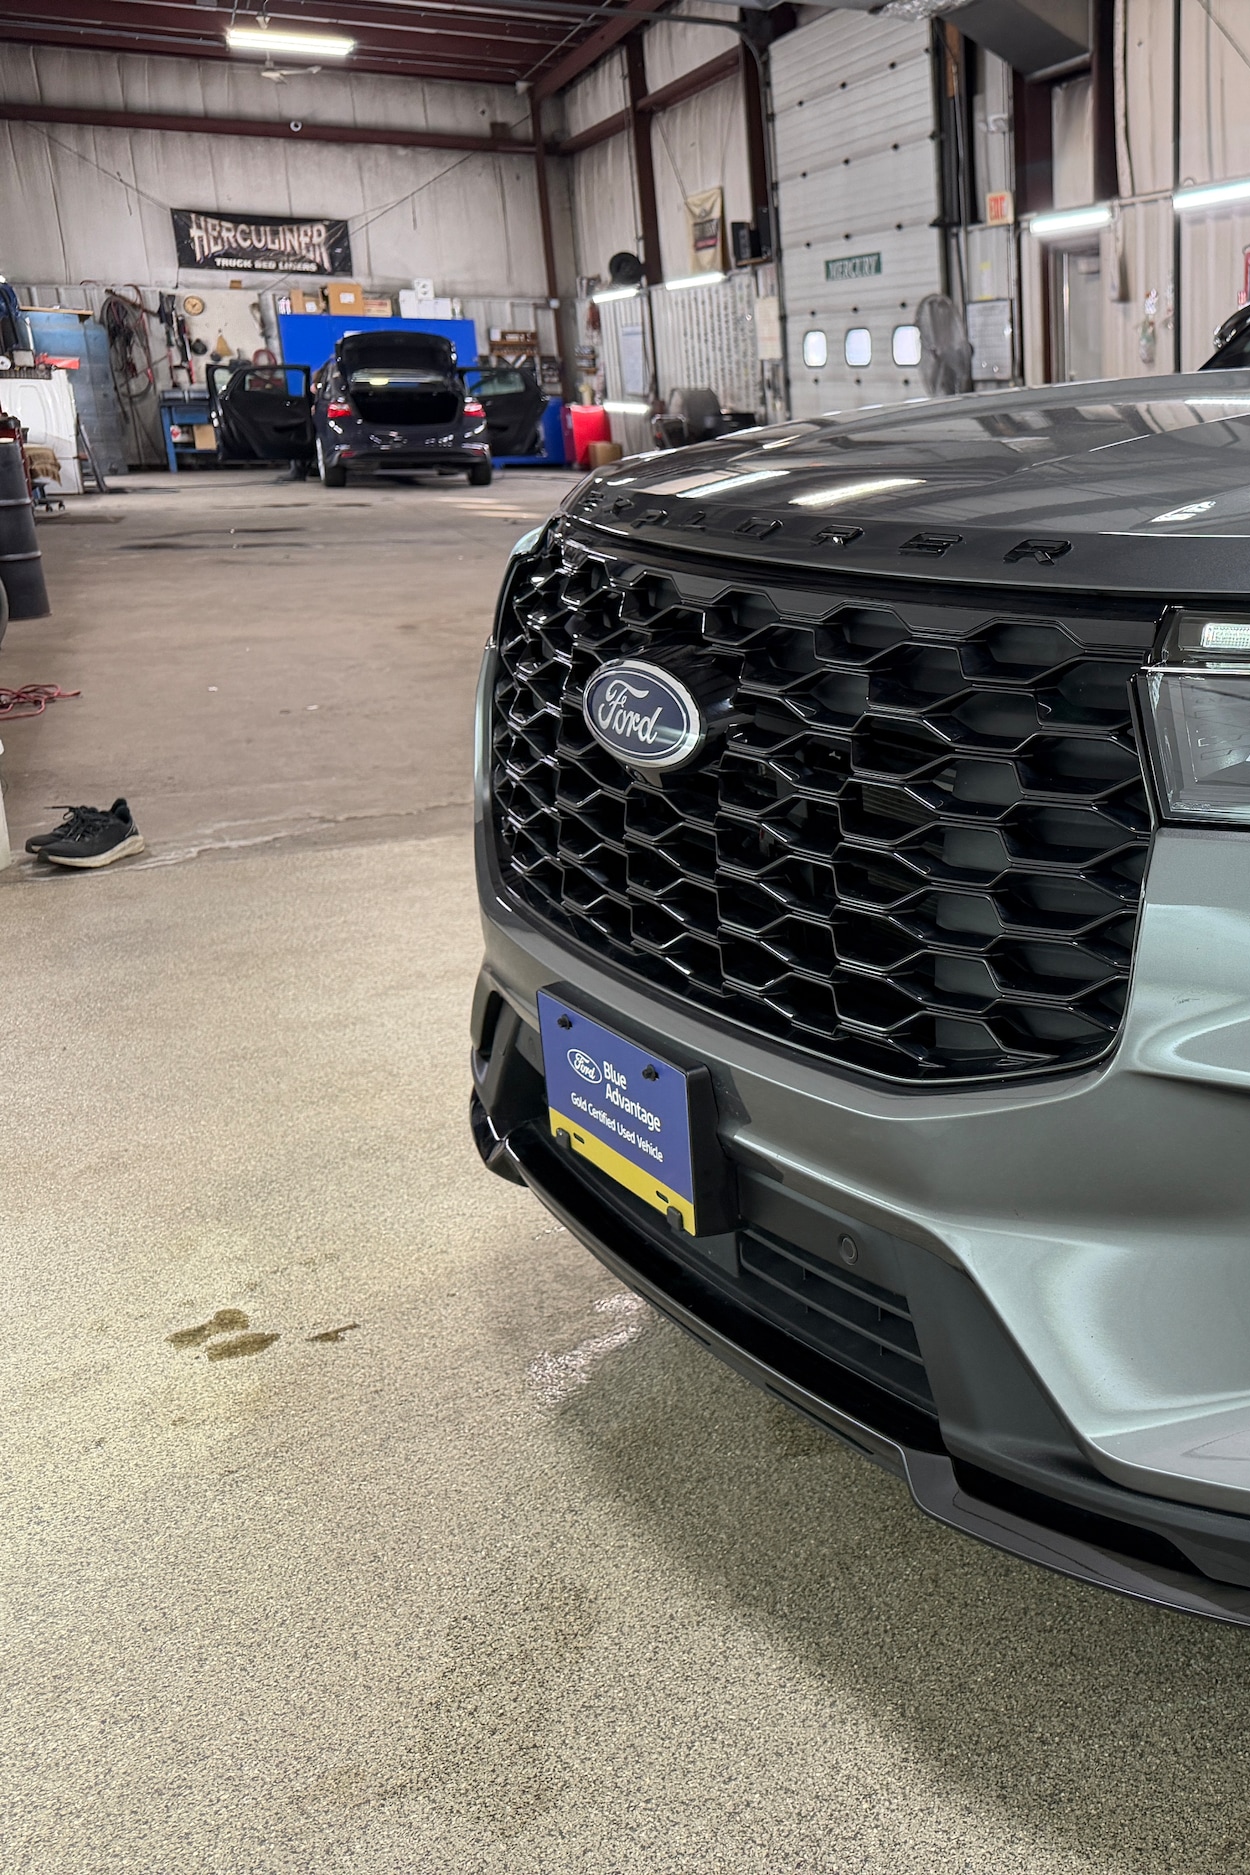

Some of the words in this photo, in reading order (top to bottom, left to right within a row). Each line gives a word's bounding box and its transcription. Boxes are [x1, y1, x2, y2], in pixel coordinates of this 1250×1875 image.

[190, 213, 332, 273] HERCULINER
[214, 257, 253, 269] TRUCK
[254, 259, 277, 270] BED
[279, 261, 318, 272] LINERS
[598, 679, 663, 744] Ford
[573, 1052, 597, 1080] Ford
[603, 1060, 627, 1090] Blue
[571, 1092, 588, 1112] Gold
[588, 1103, 616, 1131] Certified
[617, 1122, 636, 1145] Used
[636, 1134, 664, 1163] Vehicle
[605, 1083, 661, 1132] Advantage
